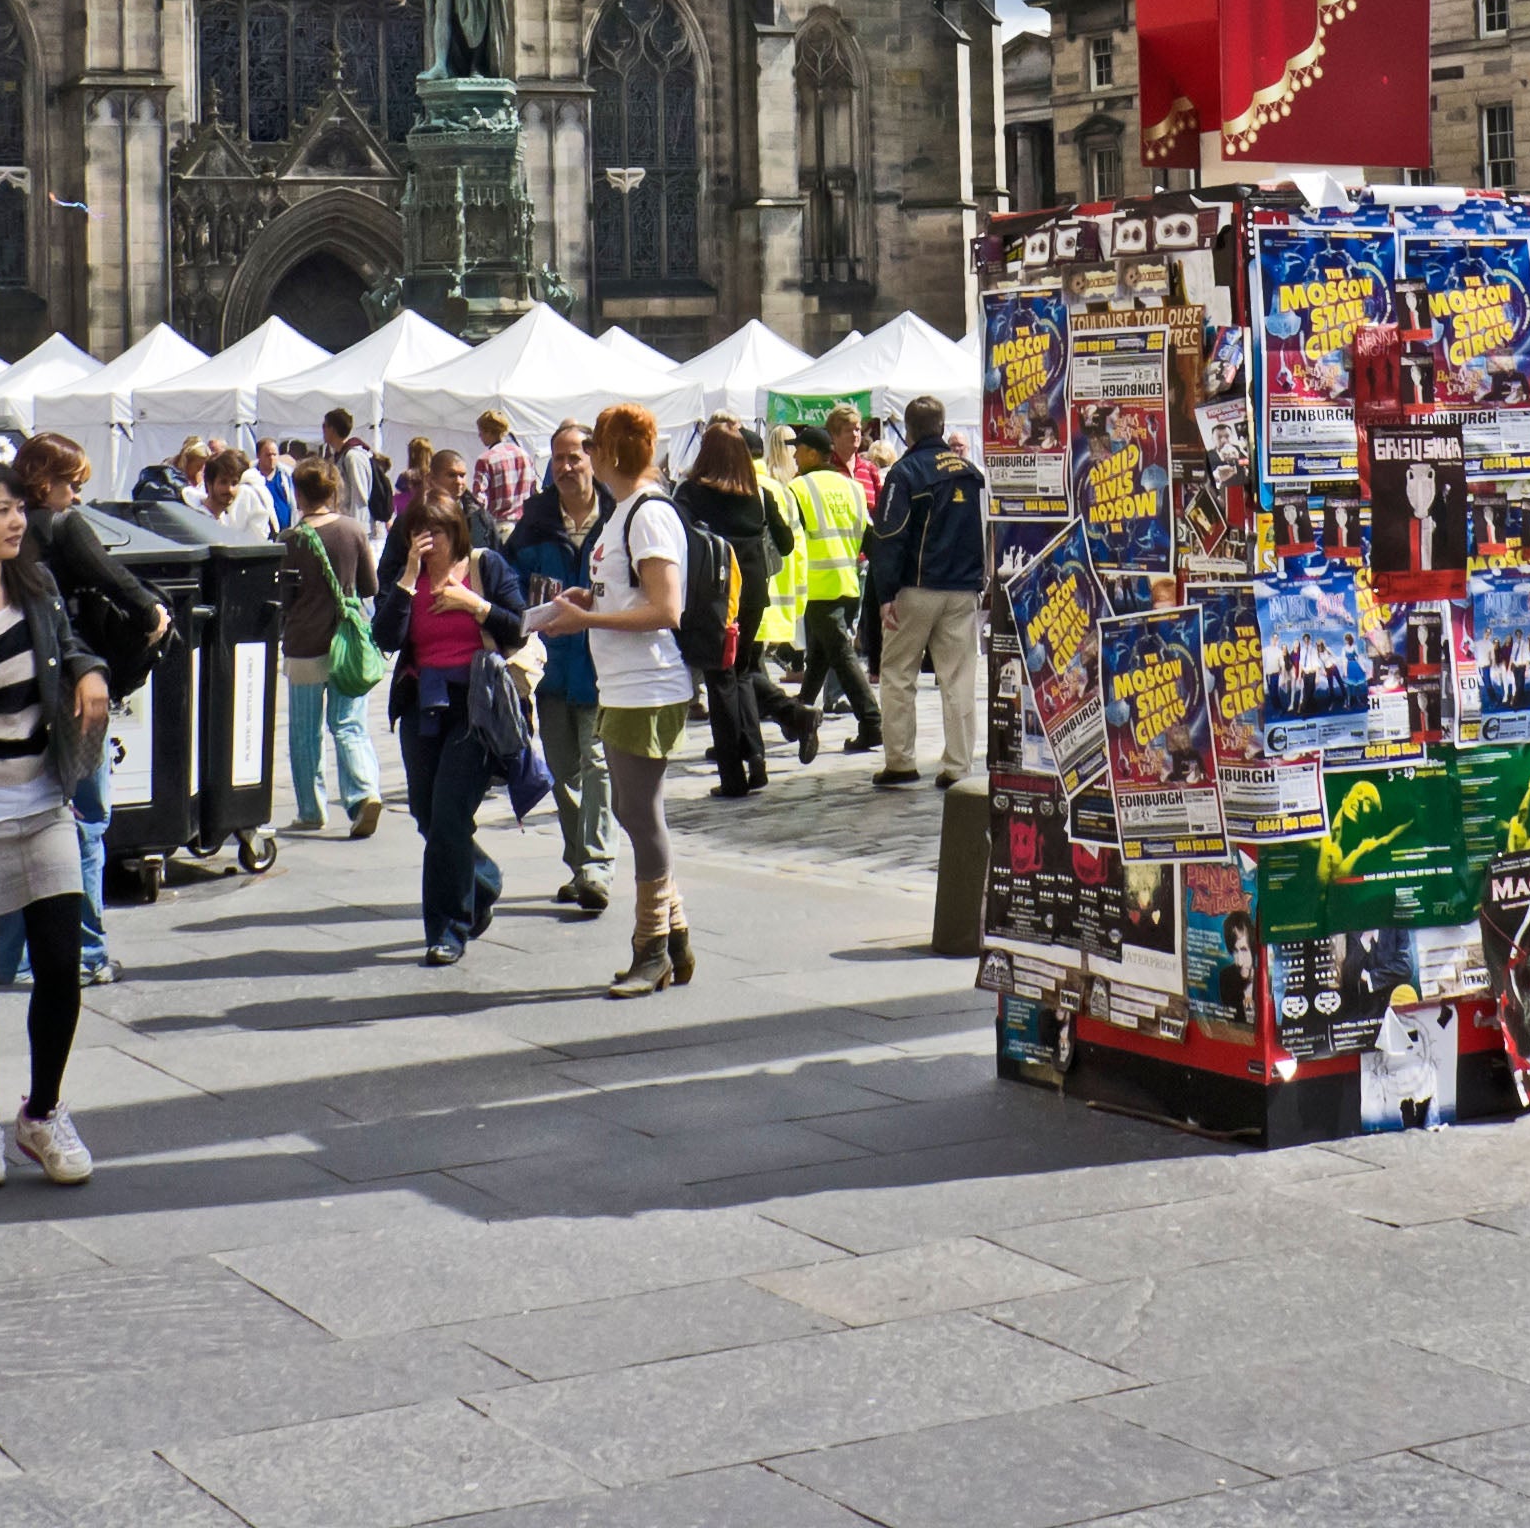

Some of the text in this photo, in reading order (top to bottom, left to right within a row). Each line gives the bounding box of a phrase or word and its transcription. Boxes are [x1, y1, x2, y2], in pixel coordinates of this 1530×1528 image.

[1325, 268, 1344, 280] THE
[1279, 277, 1374, 313] MOSCOW
[1429, 284, 1512, 319] MOSCOW
[1310, 299, 1364, 333] STATE
[1452, 306, 1506, 339] STATE
[992, 333, 1050, 368] MOSCOW
[1357, 331, 1399, 344] HENNA
[1449, 322, 1514, 366] CIRCUS
[1005, 354, 1045, 386] STATE
[1005, 371, 1047, 412] CIRCUS
[1102, 382, 1163, 398] EDINBURGH
[1271, 408, 1354, 422] EDINBURGH
[986, 453, 1036, 468] EDINBURGH
[1089, 443, 1140, 484] CIRCUS
[1094, 470, 1134, 503] STATE
[1089, 490, 1158, 523] MOSCOW
[1026, 574, 1079, 647] MOSCOW
[1047, 600, 1080, 651] STATE
[1052, 607, 1091, 674] CIRCUS
[1235, 625, 1255, 638] THE
[1113, 659, 1183, 701] MOSCOW
[1136, 684, 1179, 717] STATE
[1050, 696, 1102, 748] EDINBURGH
[1135, 699, 1186, 746] CIRCUS
[1118, 791, 1184, 809] EDINBURGH
